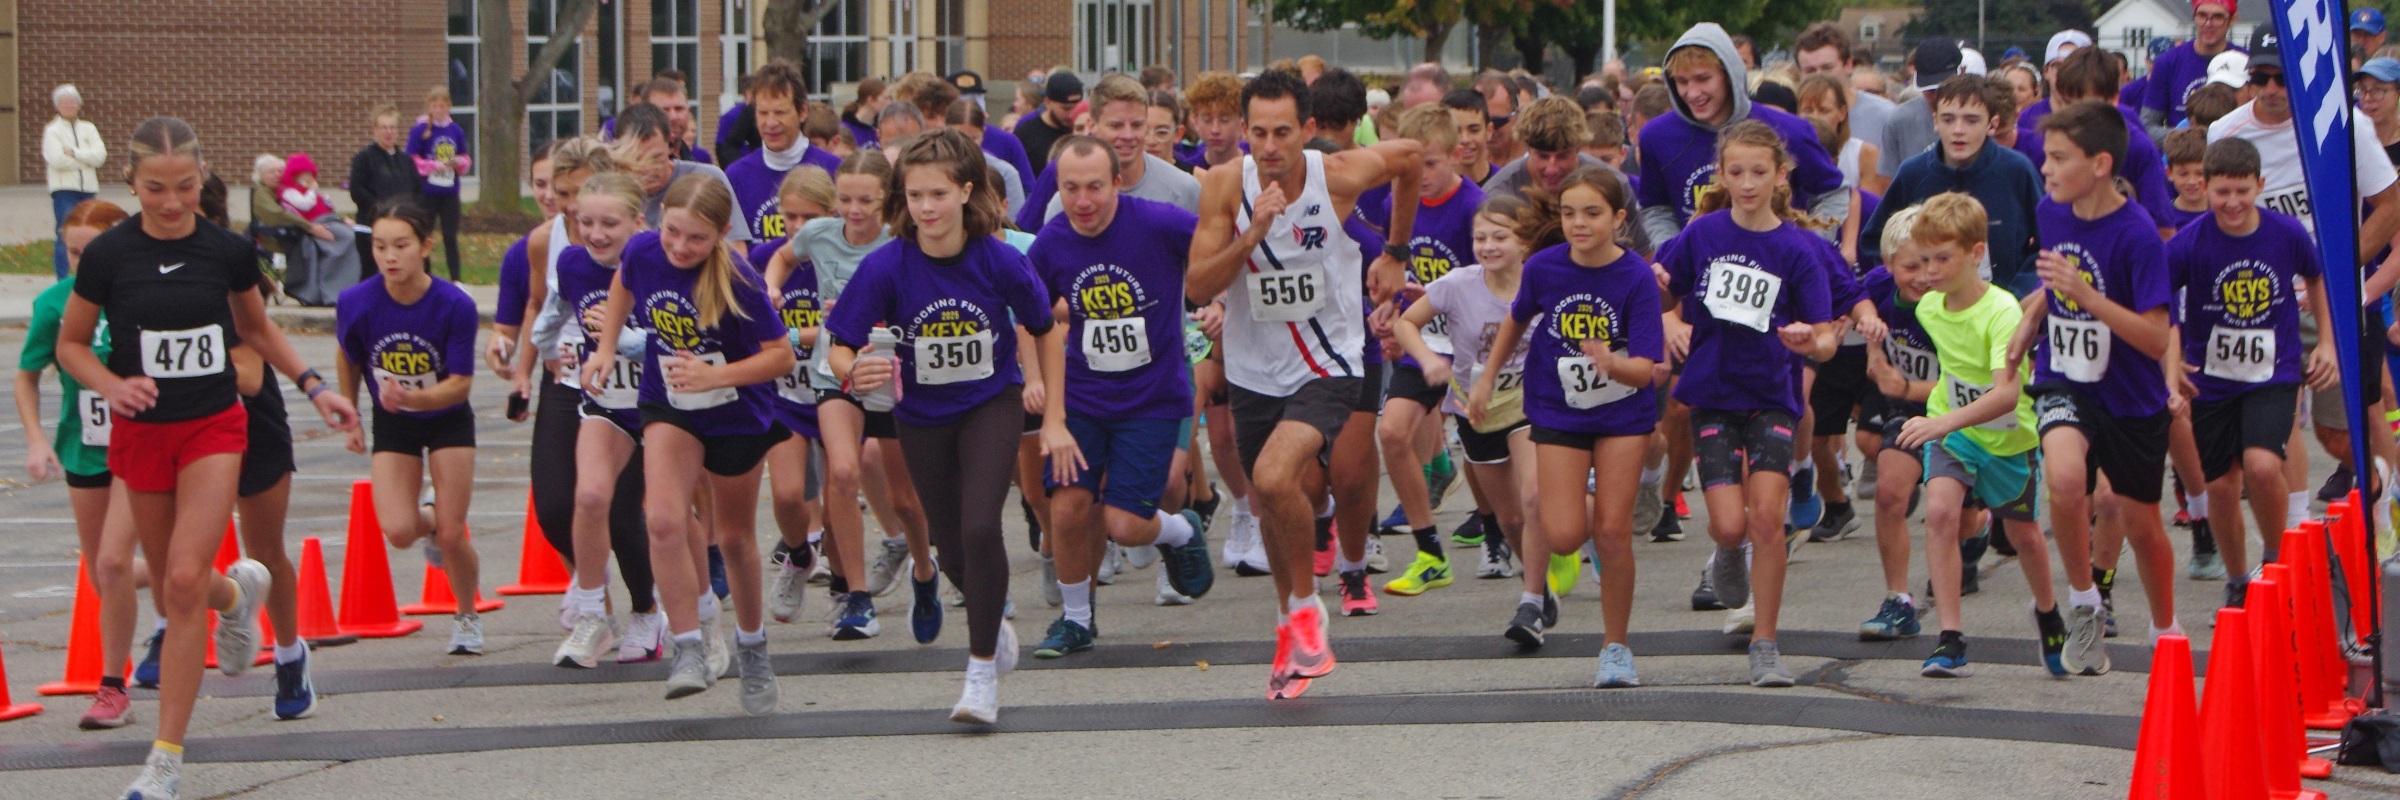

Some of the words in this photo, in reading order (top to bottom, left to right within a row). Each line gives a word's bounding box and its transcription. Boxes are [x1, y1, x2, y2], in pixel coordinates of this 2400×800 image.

[2283, 0, 2349, 157] RT
[1683, 164, 1715, 205] UNLOCKIN
[753, 195, 781, 234] UNLOCKIN
[2264, 190, 2311, 218] 505
[762, 214, 786, 238] KE
[1080, 281, 1133, 312] KEYS
[1108, 264, 1146, 302] FUTURES
[1260, 273, 1315, 306] 556
[1716, 269, 1769, 309] 398
[2222, 277, 2271, 304] KEYS
[652, 307, 695, 337] KEYS
[922, 321, 978, 337] KEYS
[1561, 313, 1610, 340] KEYS
[155, 334, 214, 371] 478
[928, 339, 982, 369] 350
[1092, 324, 1138, 354] 456
[2054, 324, 2099, 362] 476
[2216, 334, 2265, 364] 546
[381, 351, 431, 375] KEYS
[603, 357, 642, 391] 16
[1570, 363, 1607, 393] 32
